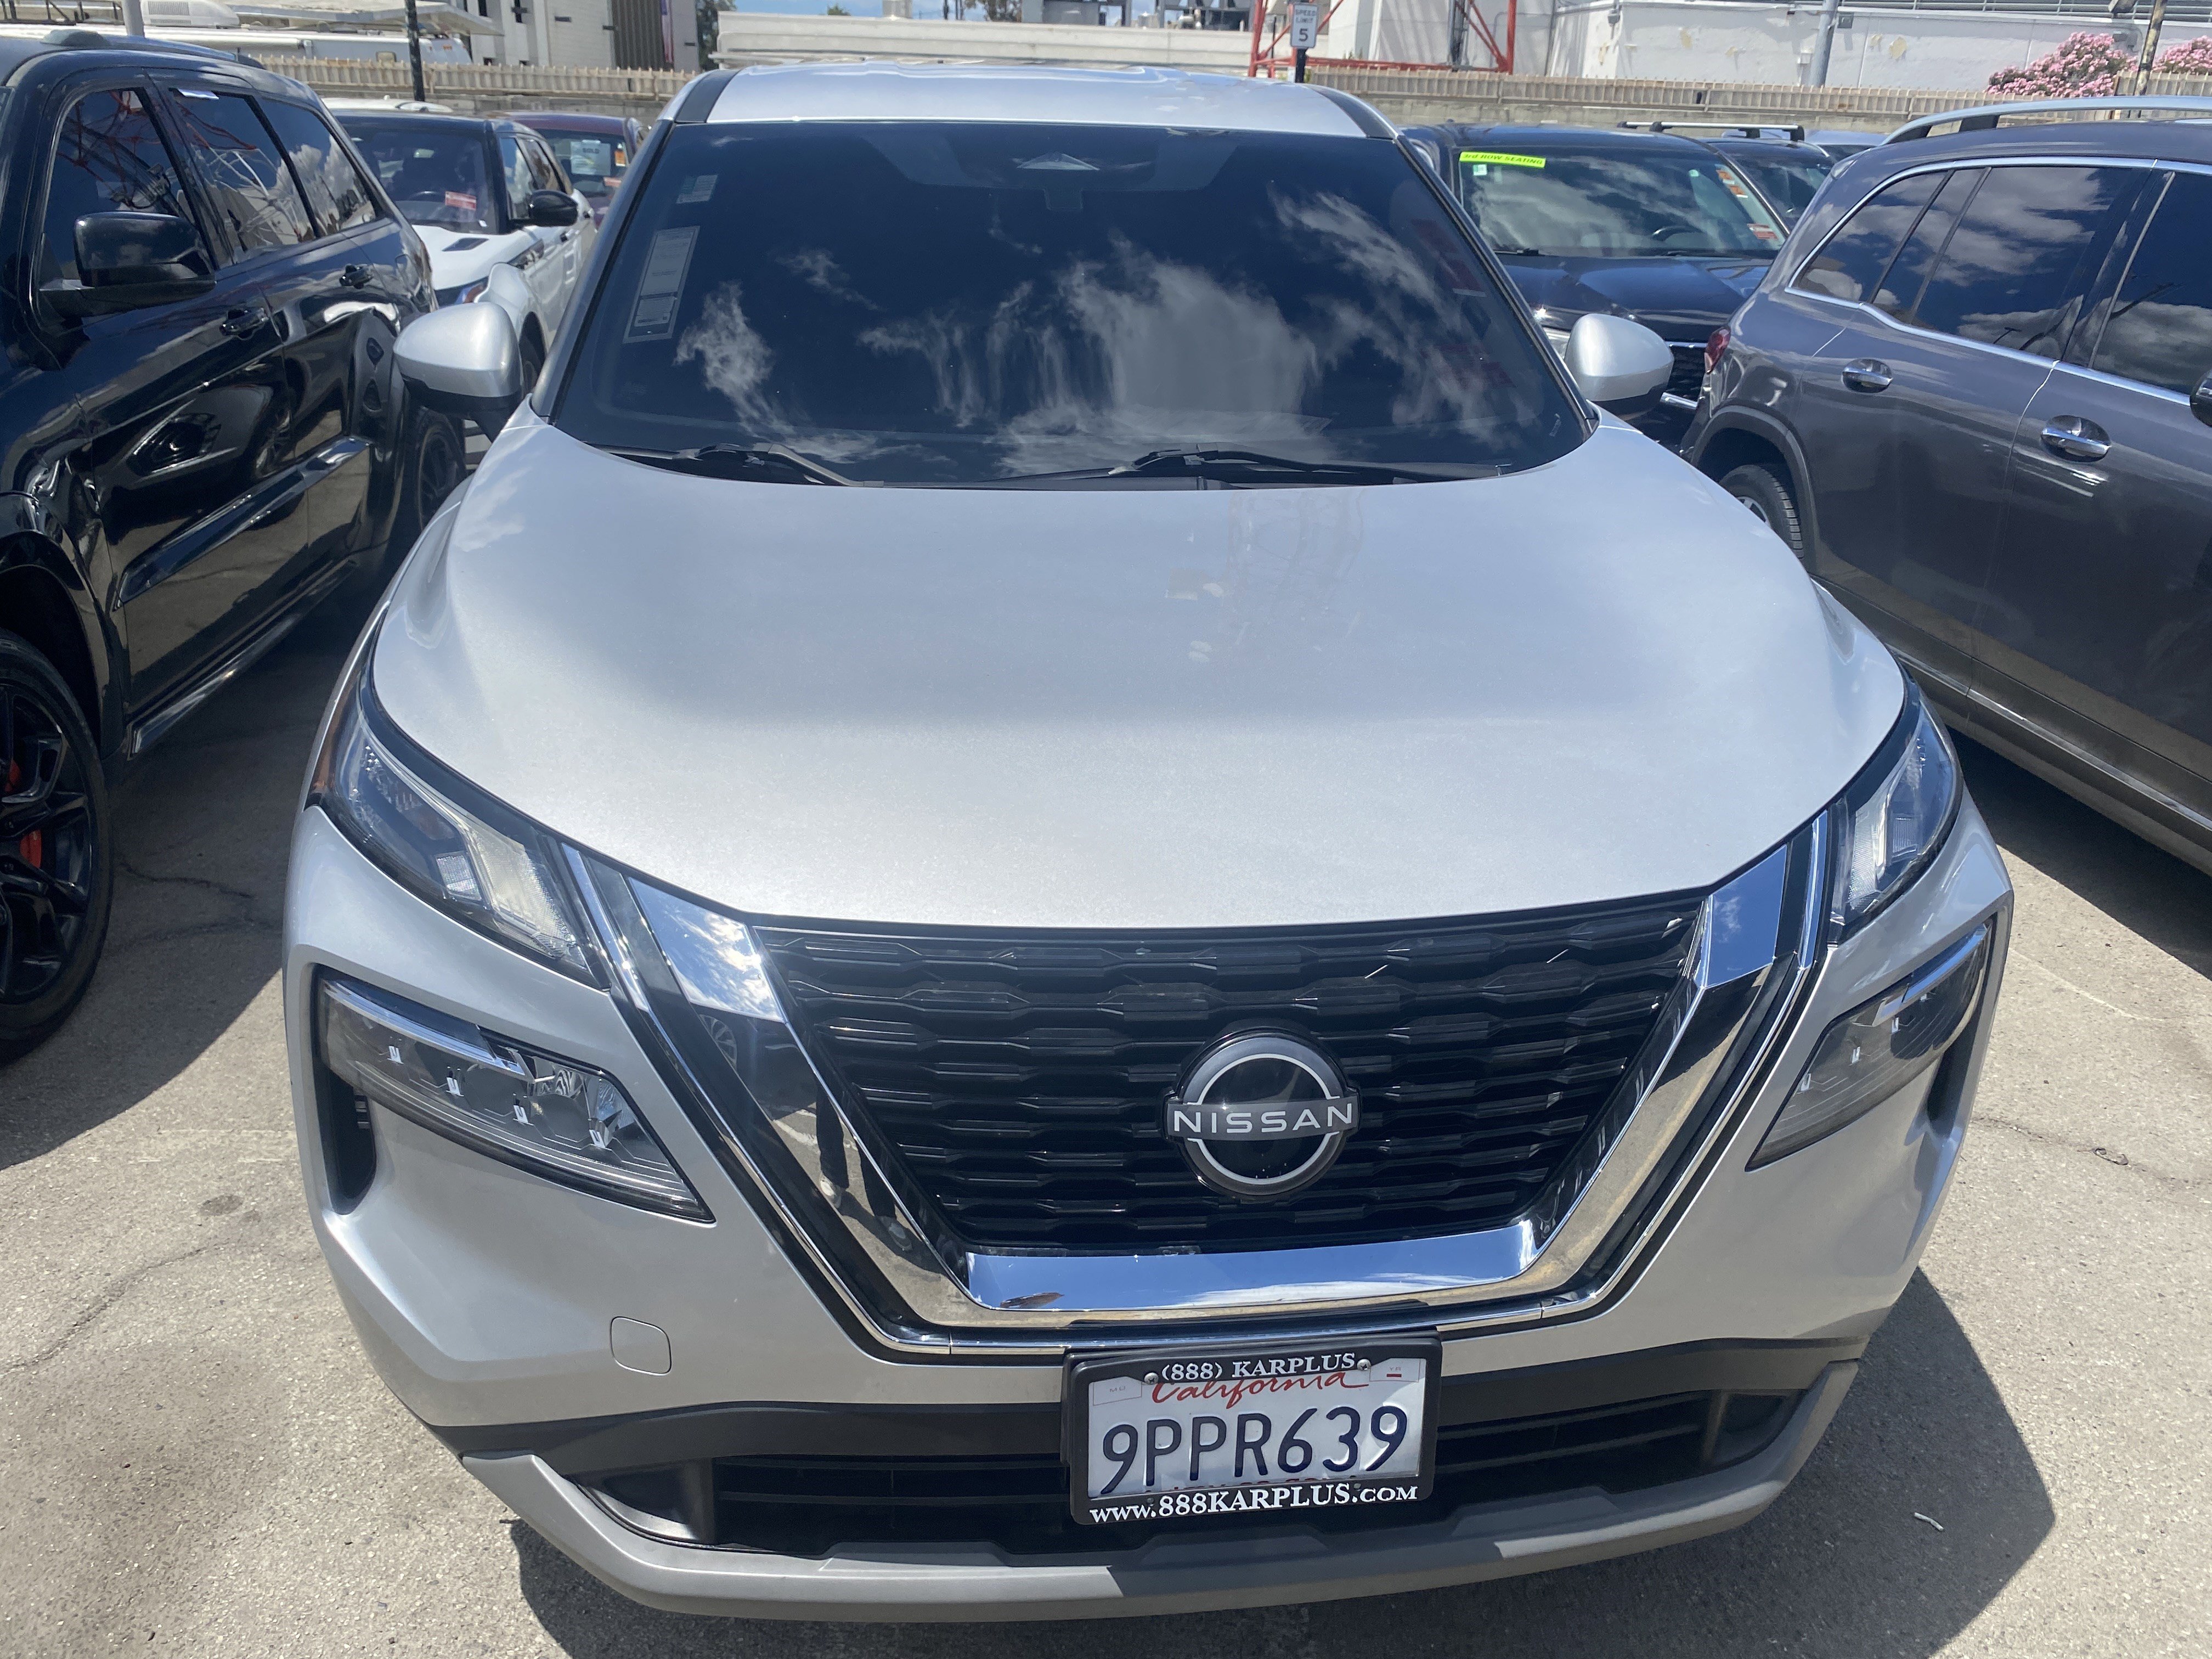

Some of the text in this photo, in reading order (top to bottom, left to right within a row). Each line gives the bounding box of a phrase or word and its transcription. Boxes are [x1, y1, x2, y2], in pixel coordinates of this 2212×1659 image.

[1299, 28, 1308, 42] 5
[1504, 156, 1543, 165] SEATING
[1173, 1103, 1352, 1134] NISSAN
[1161, 1352, 1356, 1381] (888) KARPLUS
[1152, 1372, 1370, 1409] California
[1101, 1405, 1408, 1494] 9PPR639
